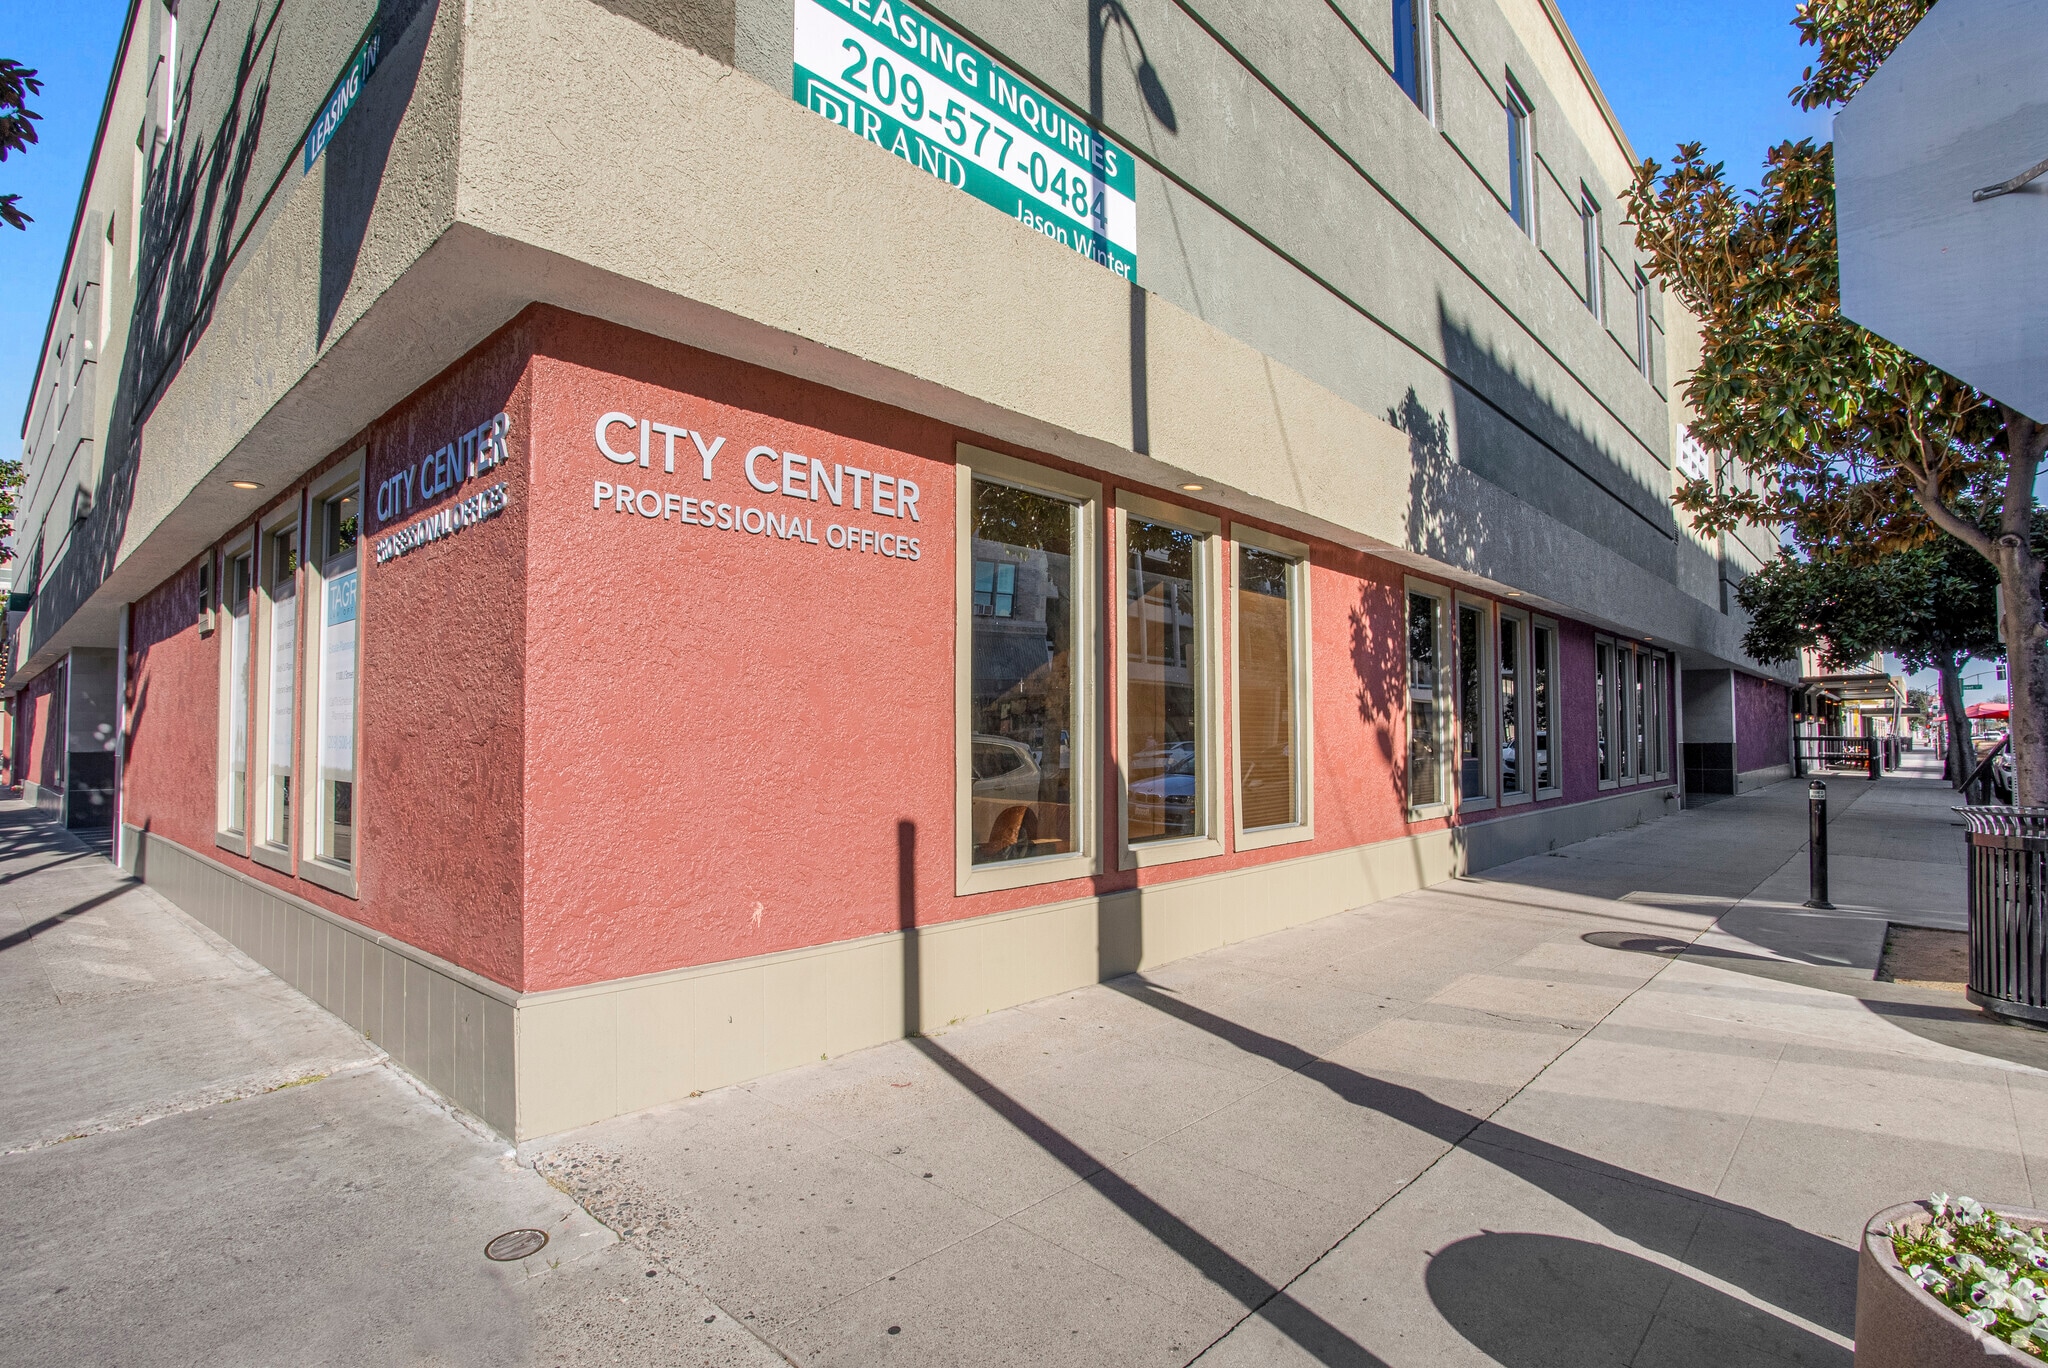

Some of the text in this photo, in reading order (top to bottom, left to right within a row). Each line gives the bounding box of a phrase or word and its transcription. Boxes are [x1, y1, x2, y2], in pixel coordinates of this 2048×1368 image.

[311, 64, 359, 162] LEASING
[840, 38, 1108, 230] 209-577-0484
[989, 69, 1118, 177] INQUIRIES
[1014, 199, 1131, 279] Jason Winter
[376, 411, 511, 522] CITY CENTER
[594, 411, 921, 521] CITY CENTER
[376, 481, 508, 563] PROFESSIONAL OFFICES
[593, 480, 921, 561] PROFESSIONAL OFFICES
